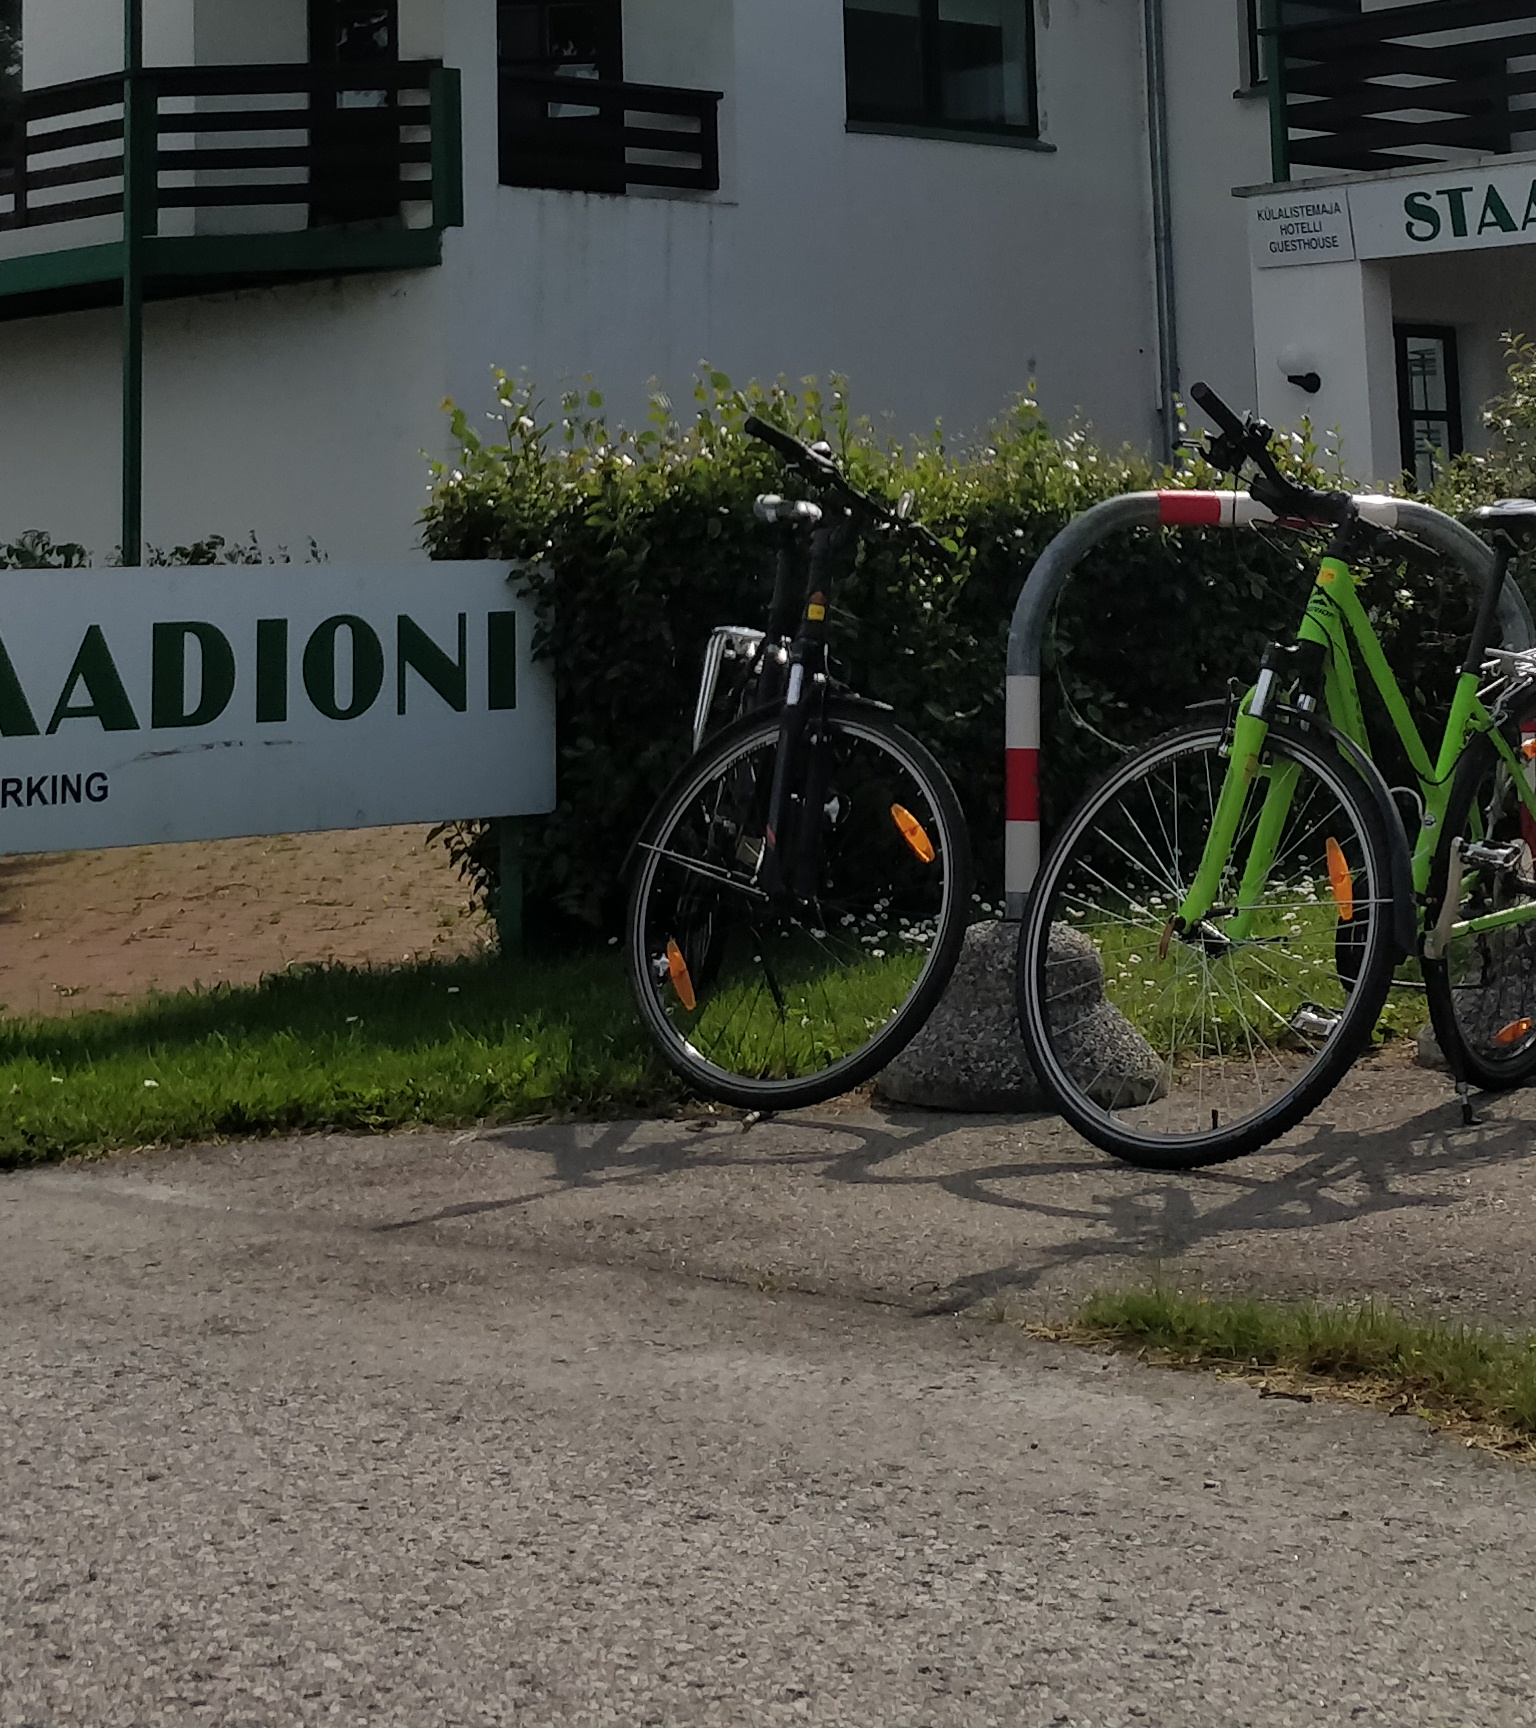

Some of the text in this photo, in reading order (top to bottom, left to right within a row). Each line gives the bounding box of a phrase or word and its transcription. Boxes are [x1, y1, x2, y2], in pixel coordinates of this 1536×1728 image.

[1257, 202, 1342, 221] KÜLALISTEMAJA
[1280, 221, 1323, 235] HOTELLI
[1269, 235, 1340, 253] GUESTHOUSE
